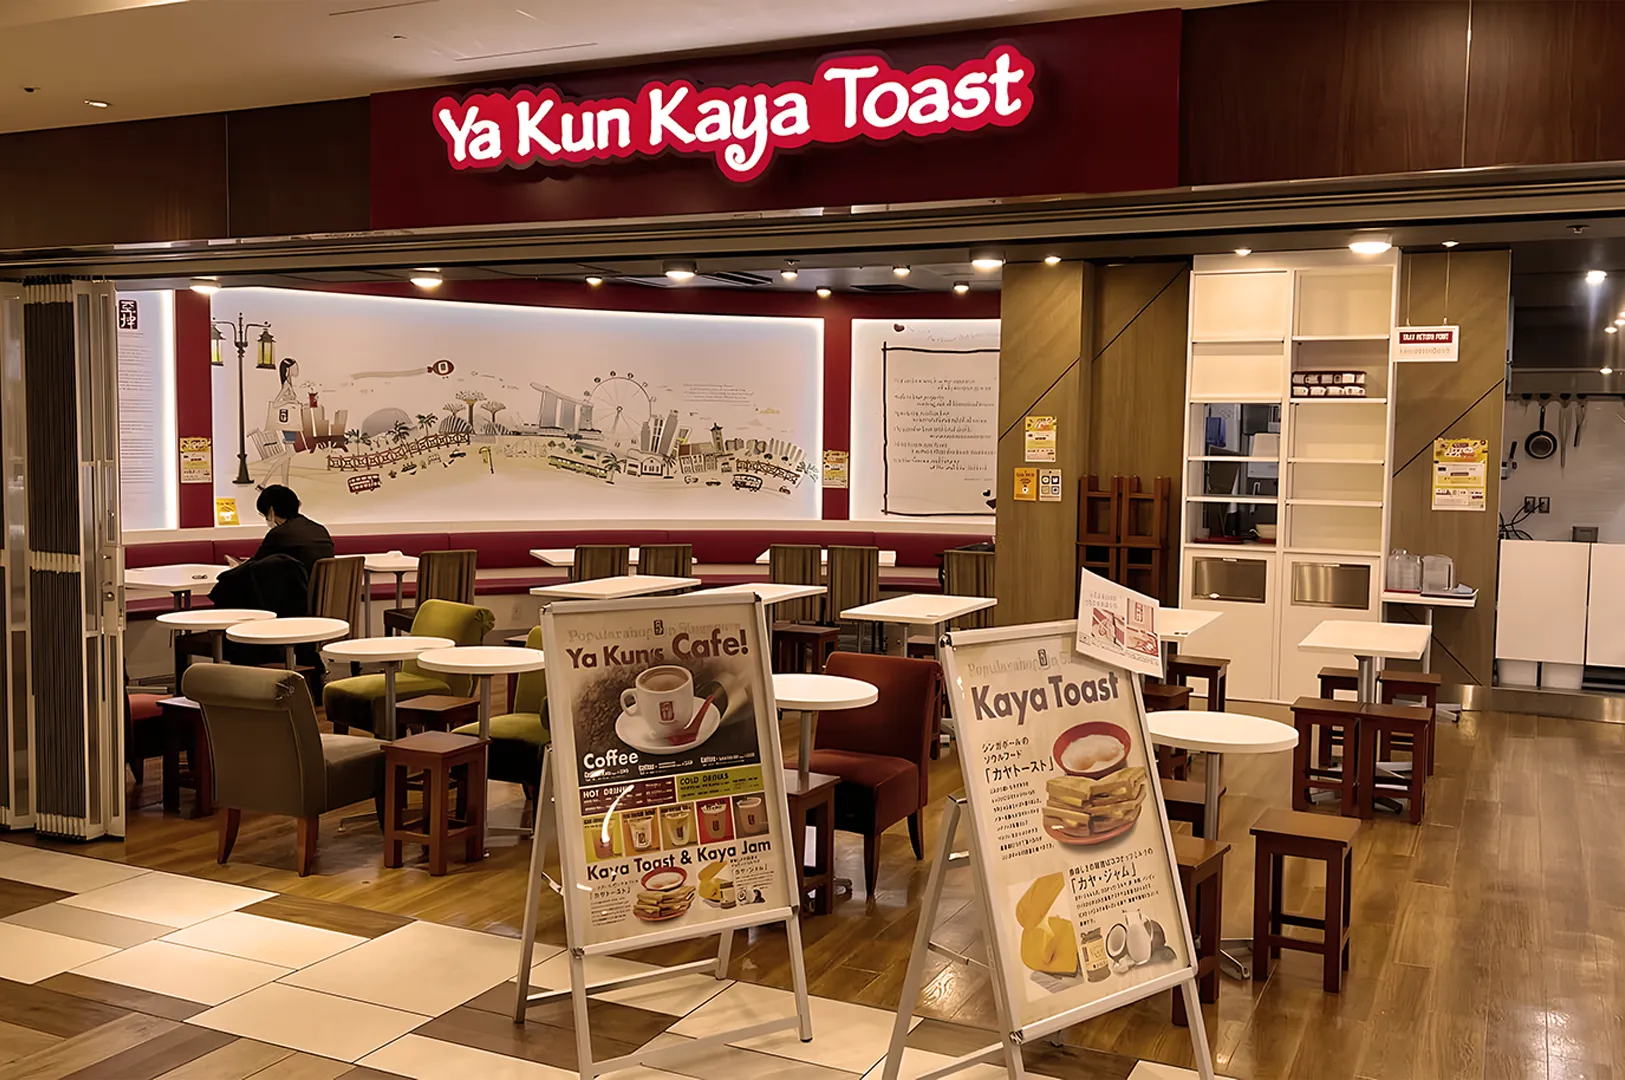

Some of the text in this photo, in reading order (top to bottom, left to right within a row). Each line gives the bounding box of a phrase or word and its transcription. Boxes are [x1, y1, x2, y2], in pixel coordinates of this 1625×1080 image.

[438, 53, 1024, 172] Ya Kun Kaya Toast
[565, 647, 597, 669] Ya
[672, 628, 749, 661] Cafe!
[971, 671, 1118, 726] Kaya Toast
[583, 749, 639, 769] Coffee
[985, 756, 1055, 784] 「カヤトースト」
[583, 789, 599, 799] HOT
[680, 776, 699, 786] COLD
[587, 862, 630, 882] Kaya
[634, 853, 675, 873] Toast
[680, 850, 692, 864] &
[698, 844, 737, 863] Kaya
[742, 840, 771, 854] Jam
[1071, 862, 1136, 893] 「カヤ・ジャム」
